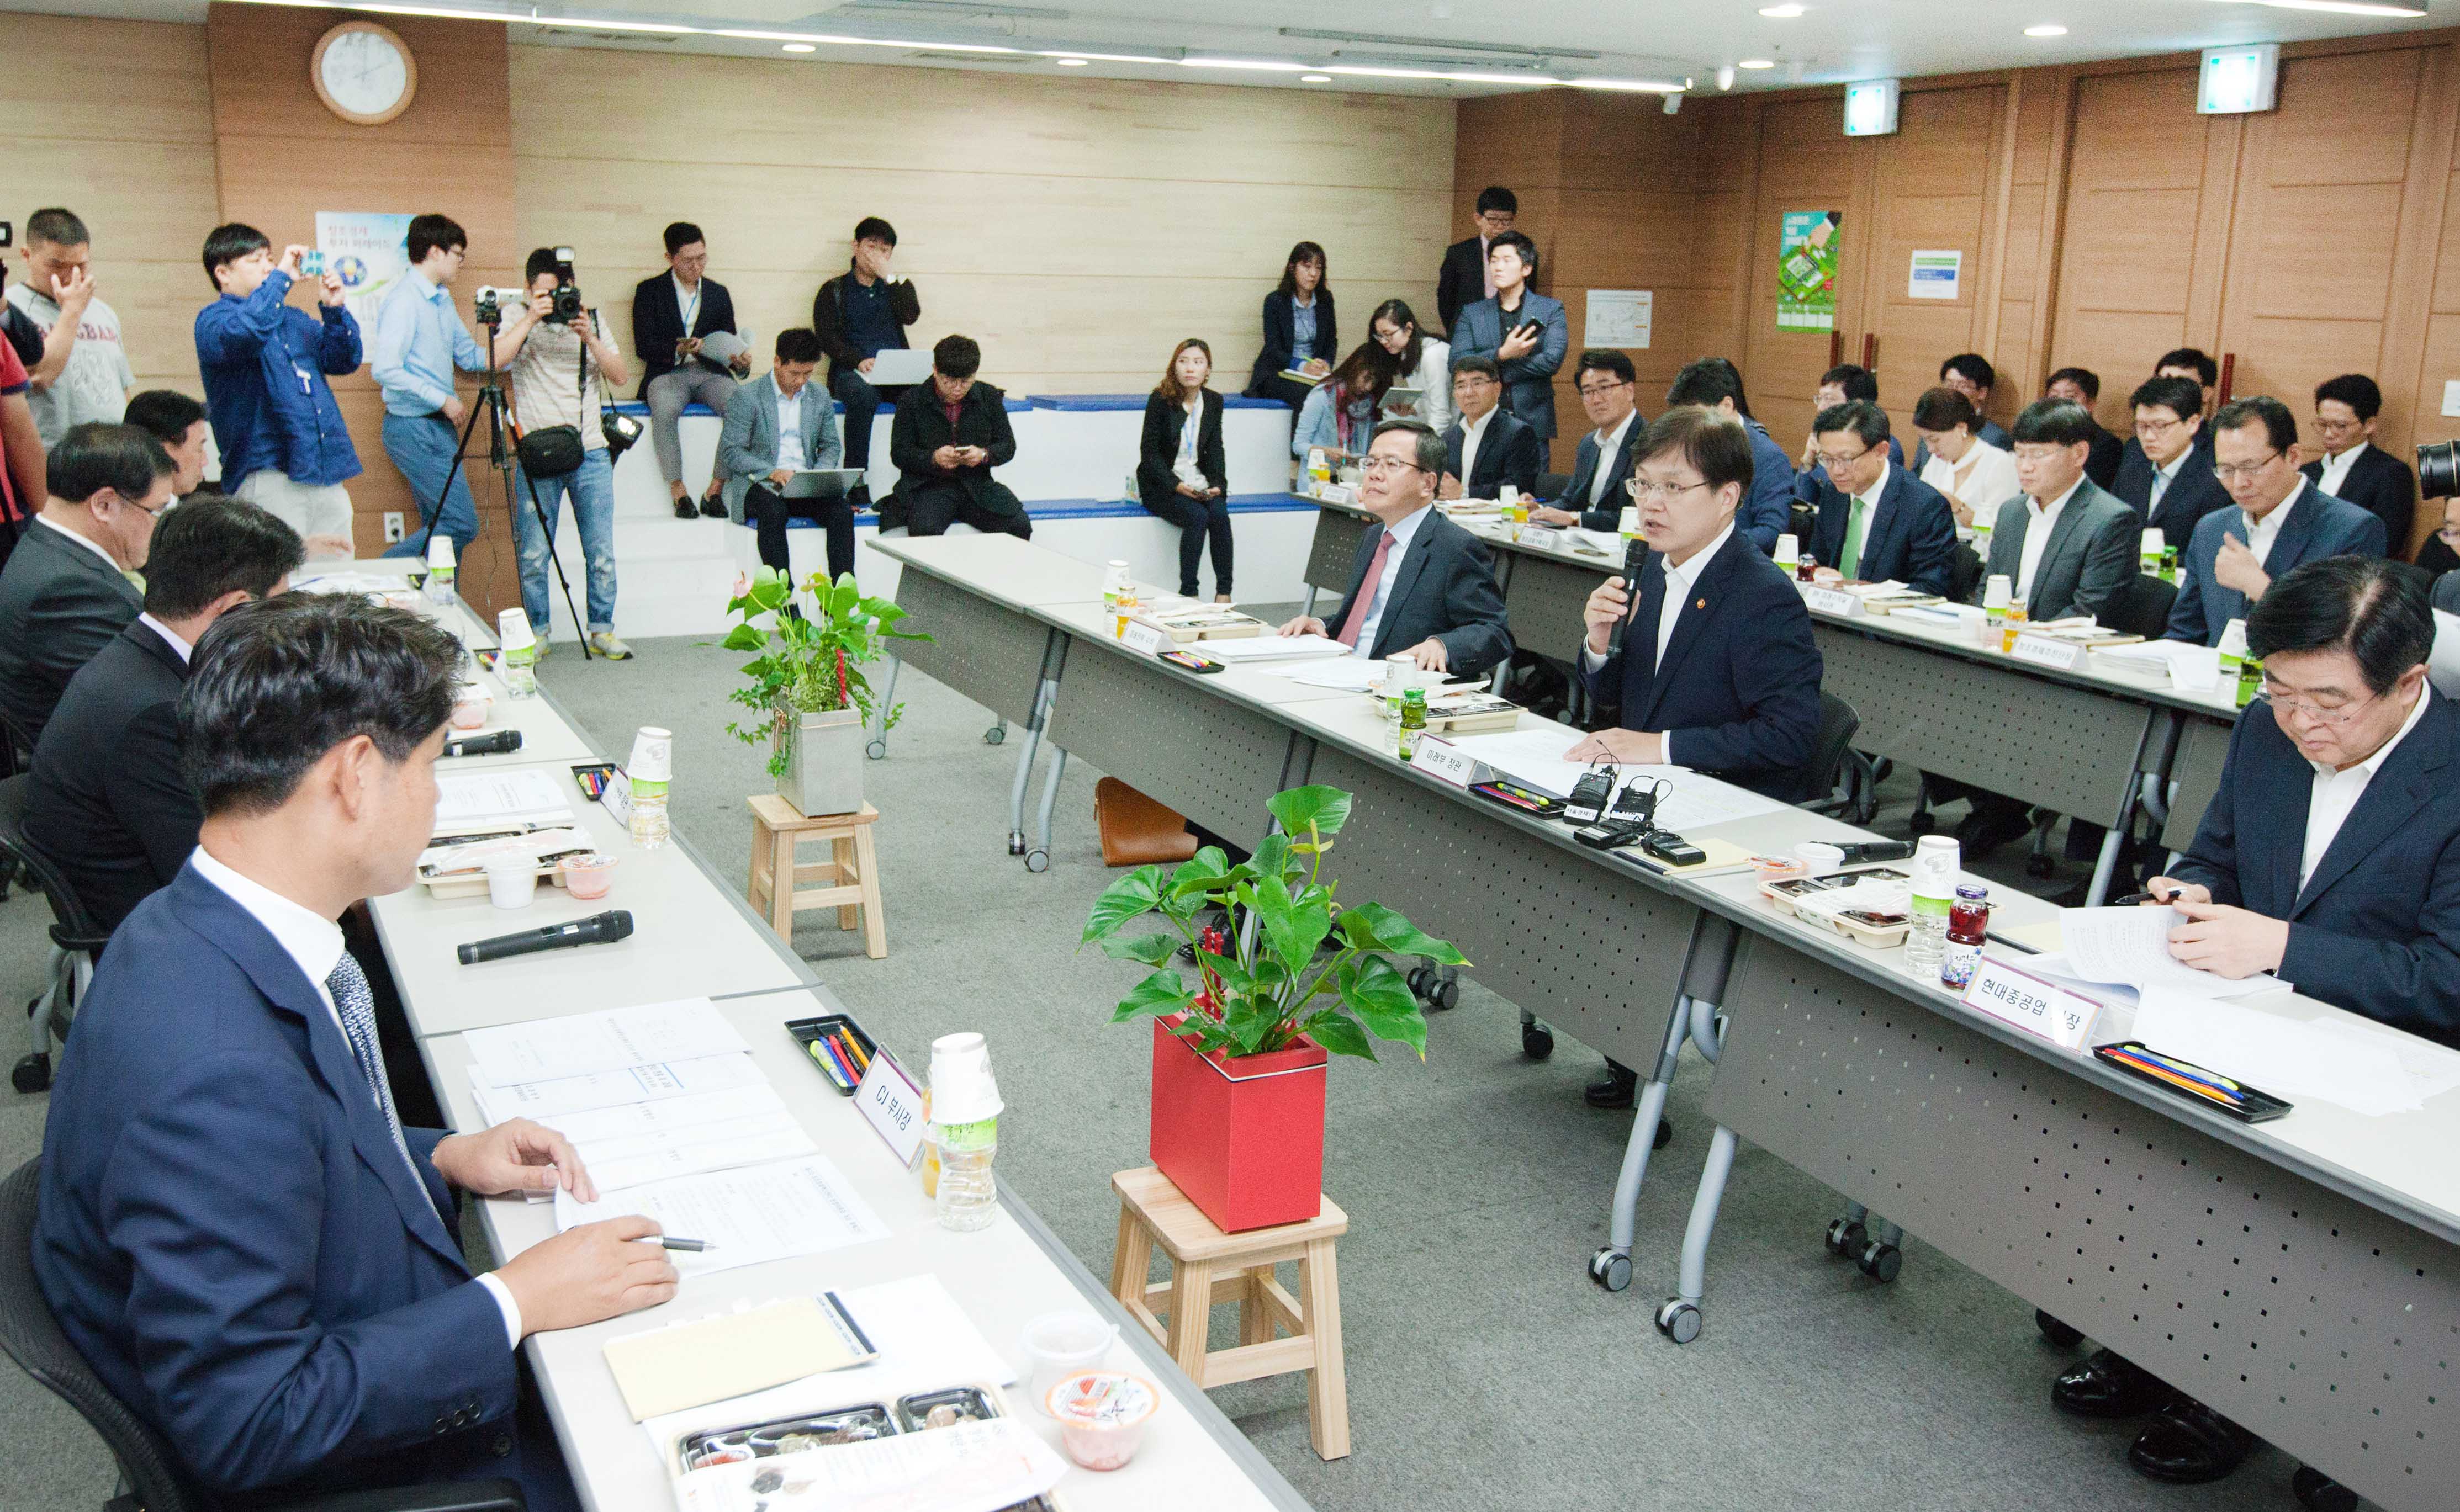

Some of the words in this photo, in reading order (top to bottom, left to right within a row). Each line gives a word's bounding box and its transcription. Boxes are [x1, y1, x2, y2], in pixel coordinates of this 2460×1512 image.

[1426, 749, 1447, 764] 미래부
[1447, 758, 1462, 772] 장관
[1981, 979, 2047, 1016] 현대중공업
[876, 1085, 890, 1105] CJ
[887, 1096, 912, 1131] 부사장
